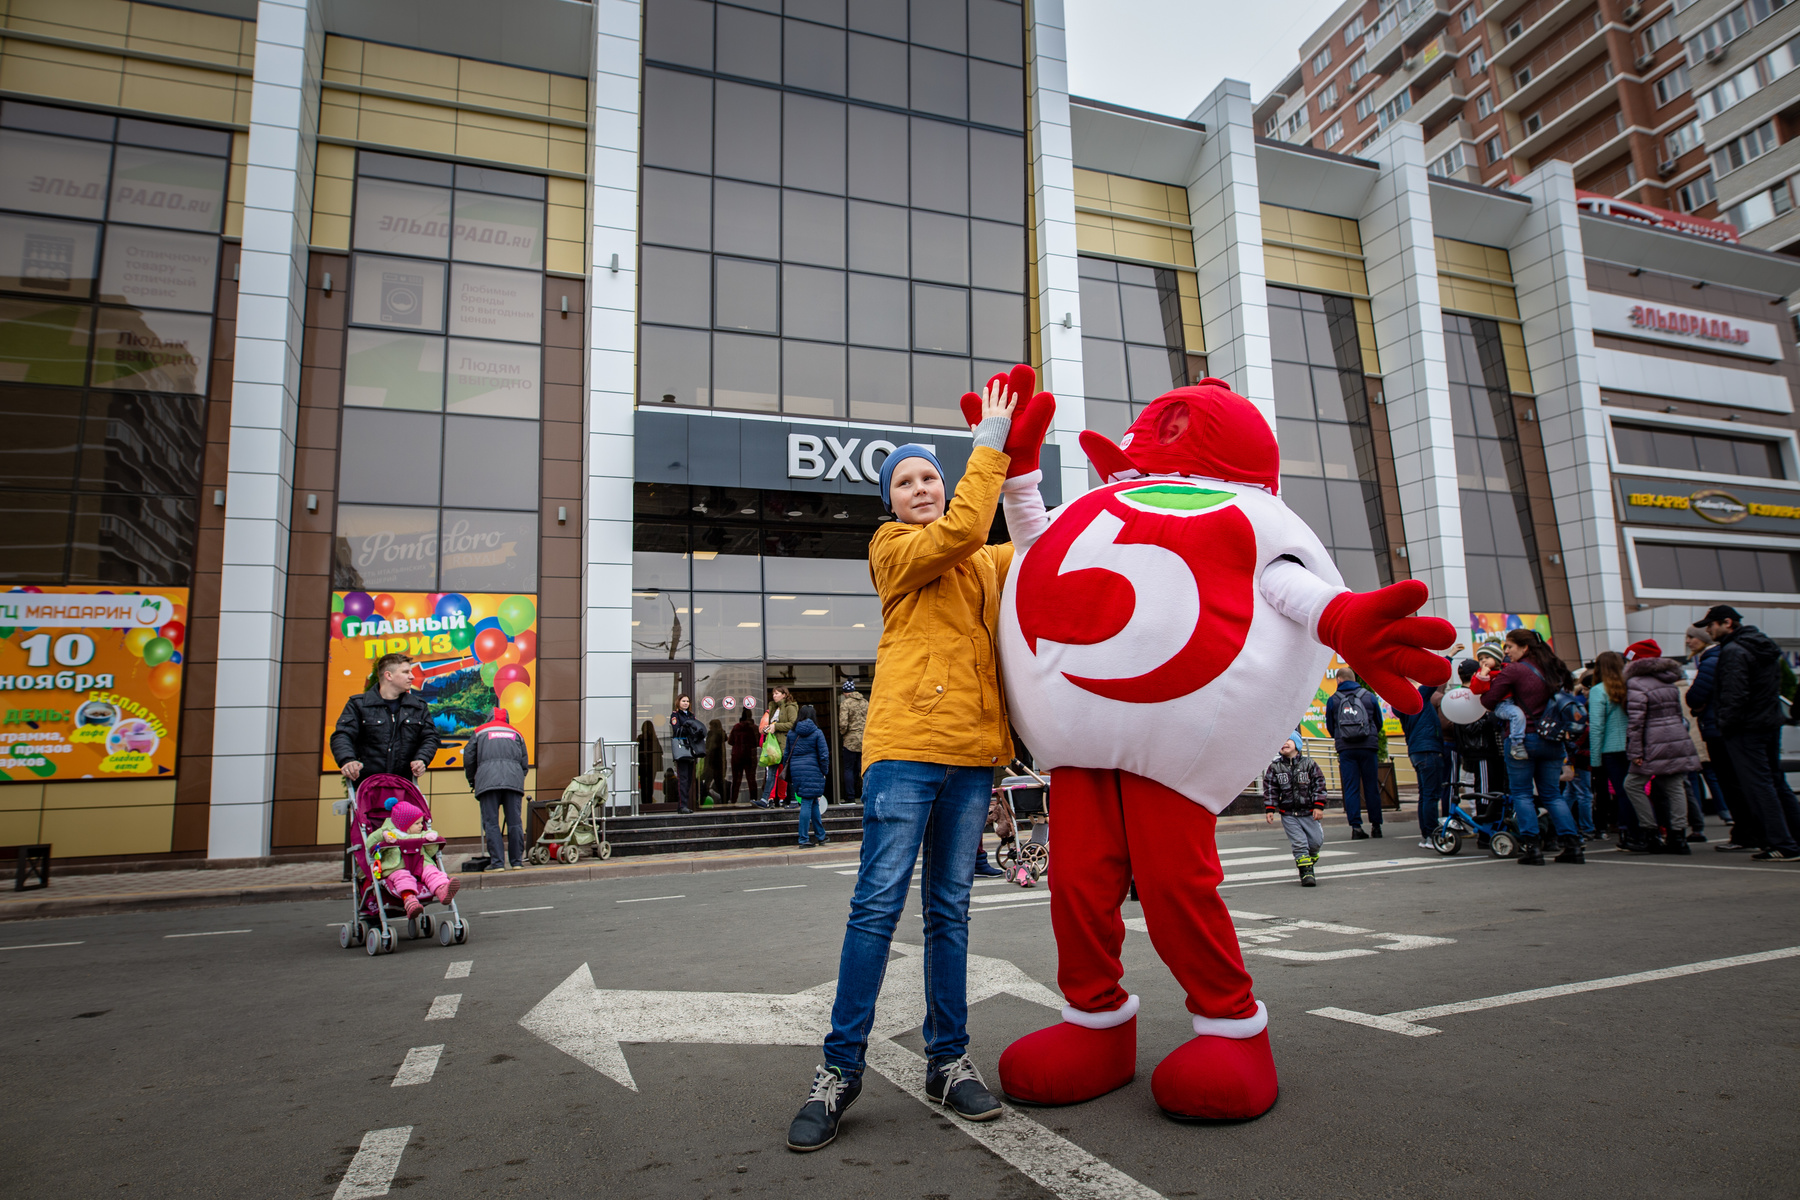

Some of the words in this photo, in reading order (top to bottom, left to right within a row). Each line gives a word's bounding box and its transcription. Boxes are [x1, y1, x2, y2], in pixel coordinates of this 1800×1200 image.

[26, 176, 211, 213] ЭЛЬДРАДО.RU
[126, 246, 210, 266] Отличному
[125, 260, 176, 274] товару
[123, 272, 197, 288] отличный
[122, 284, 177, 298] сервис
[461, 283, 517, 298] Любимые
[461, 293, 505, 306] бренды
[460, 304, 475, 313] по
[477, 307, 534, 318] выгодным
[460, 315, 497, 325] ценам
[117, 331, 188, 350] Людям
[115, 348, 202, 368] выгодно
[459, 357, 521, 375] Людям
[458, 374, 532, 390] выгодно
[788, 433, 936, 485] ВХО
[453, 552, 499, 567] ROYAL
[25, 605, 132, 620] МАНДАРИН
[347, 610, 467, 637] ГЛАВНЫЙ
[20, 633, 95, 667] 10
[364, 634, 454, 660] ПРИЗ
[0, 670, 115, 693] ноября
[3, 708, 71, 725] ДЕНЬ:
[89, 691, 168, 739] БЕСПЛАТНО
[15, 744, 73, 757] призов
